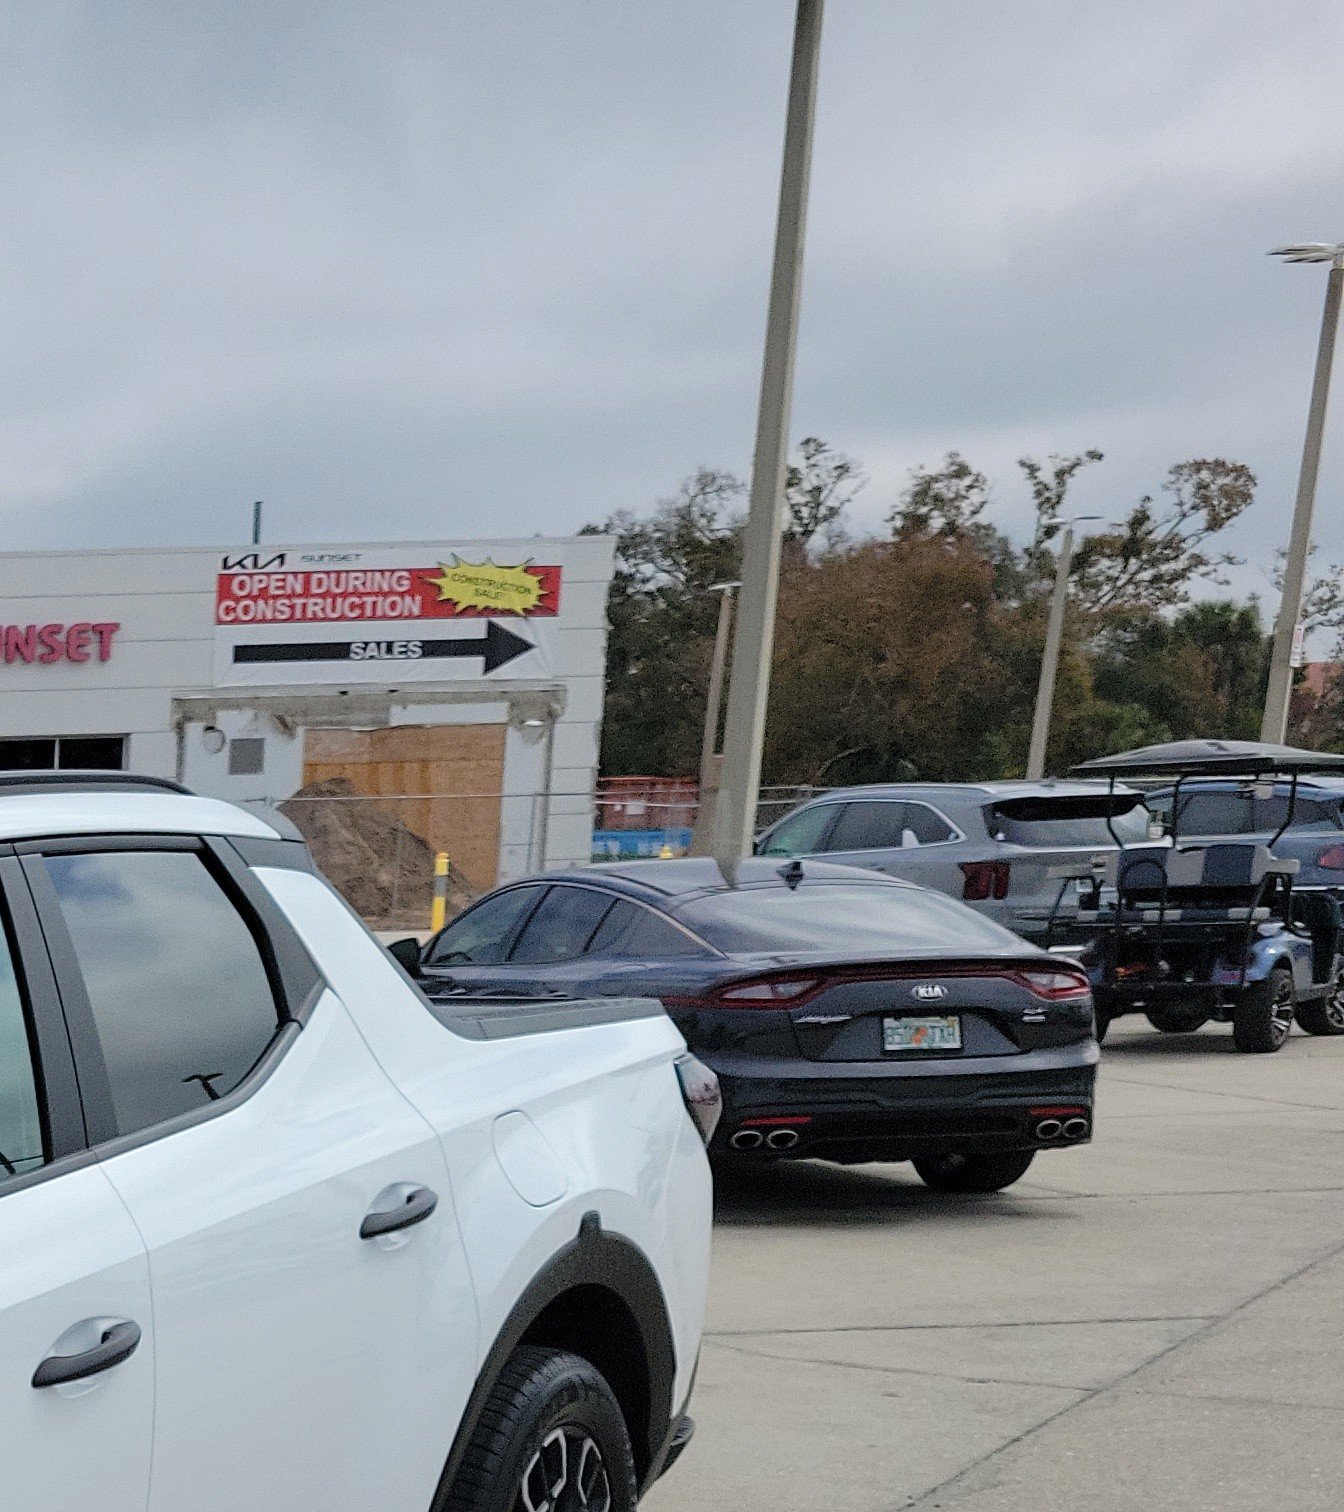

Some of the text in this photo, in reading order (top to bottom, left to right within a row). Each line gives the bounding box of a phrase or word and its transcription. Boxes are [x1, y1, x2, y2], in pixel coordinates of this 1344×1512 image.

[222, 553, 363, 570] KIA SUNSET
[231, 571, 411, 597] OPEN DURING
[218, 595, 423, 622] CONSTRUCTION
[348, 641, 424, 660] SALES
[915, 985, 946, 999] KIA
